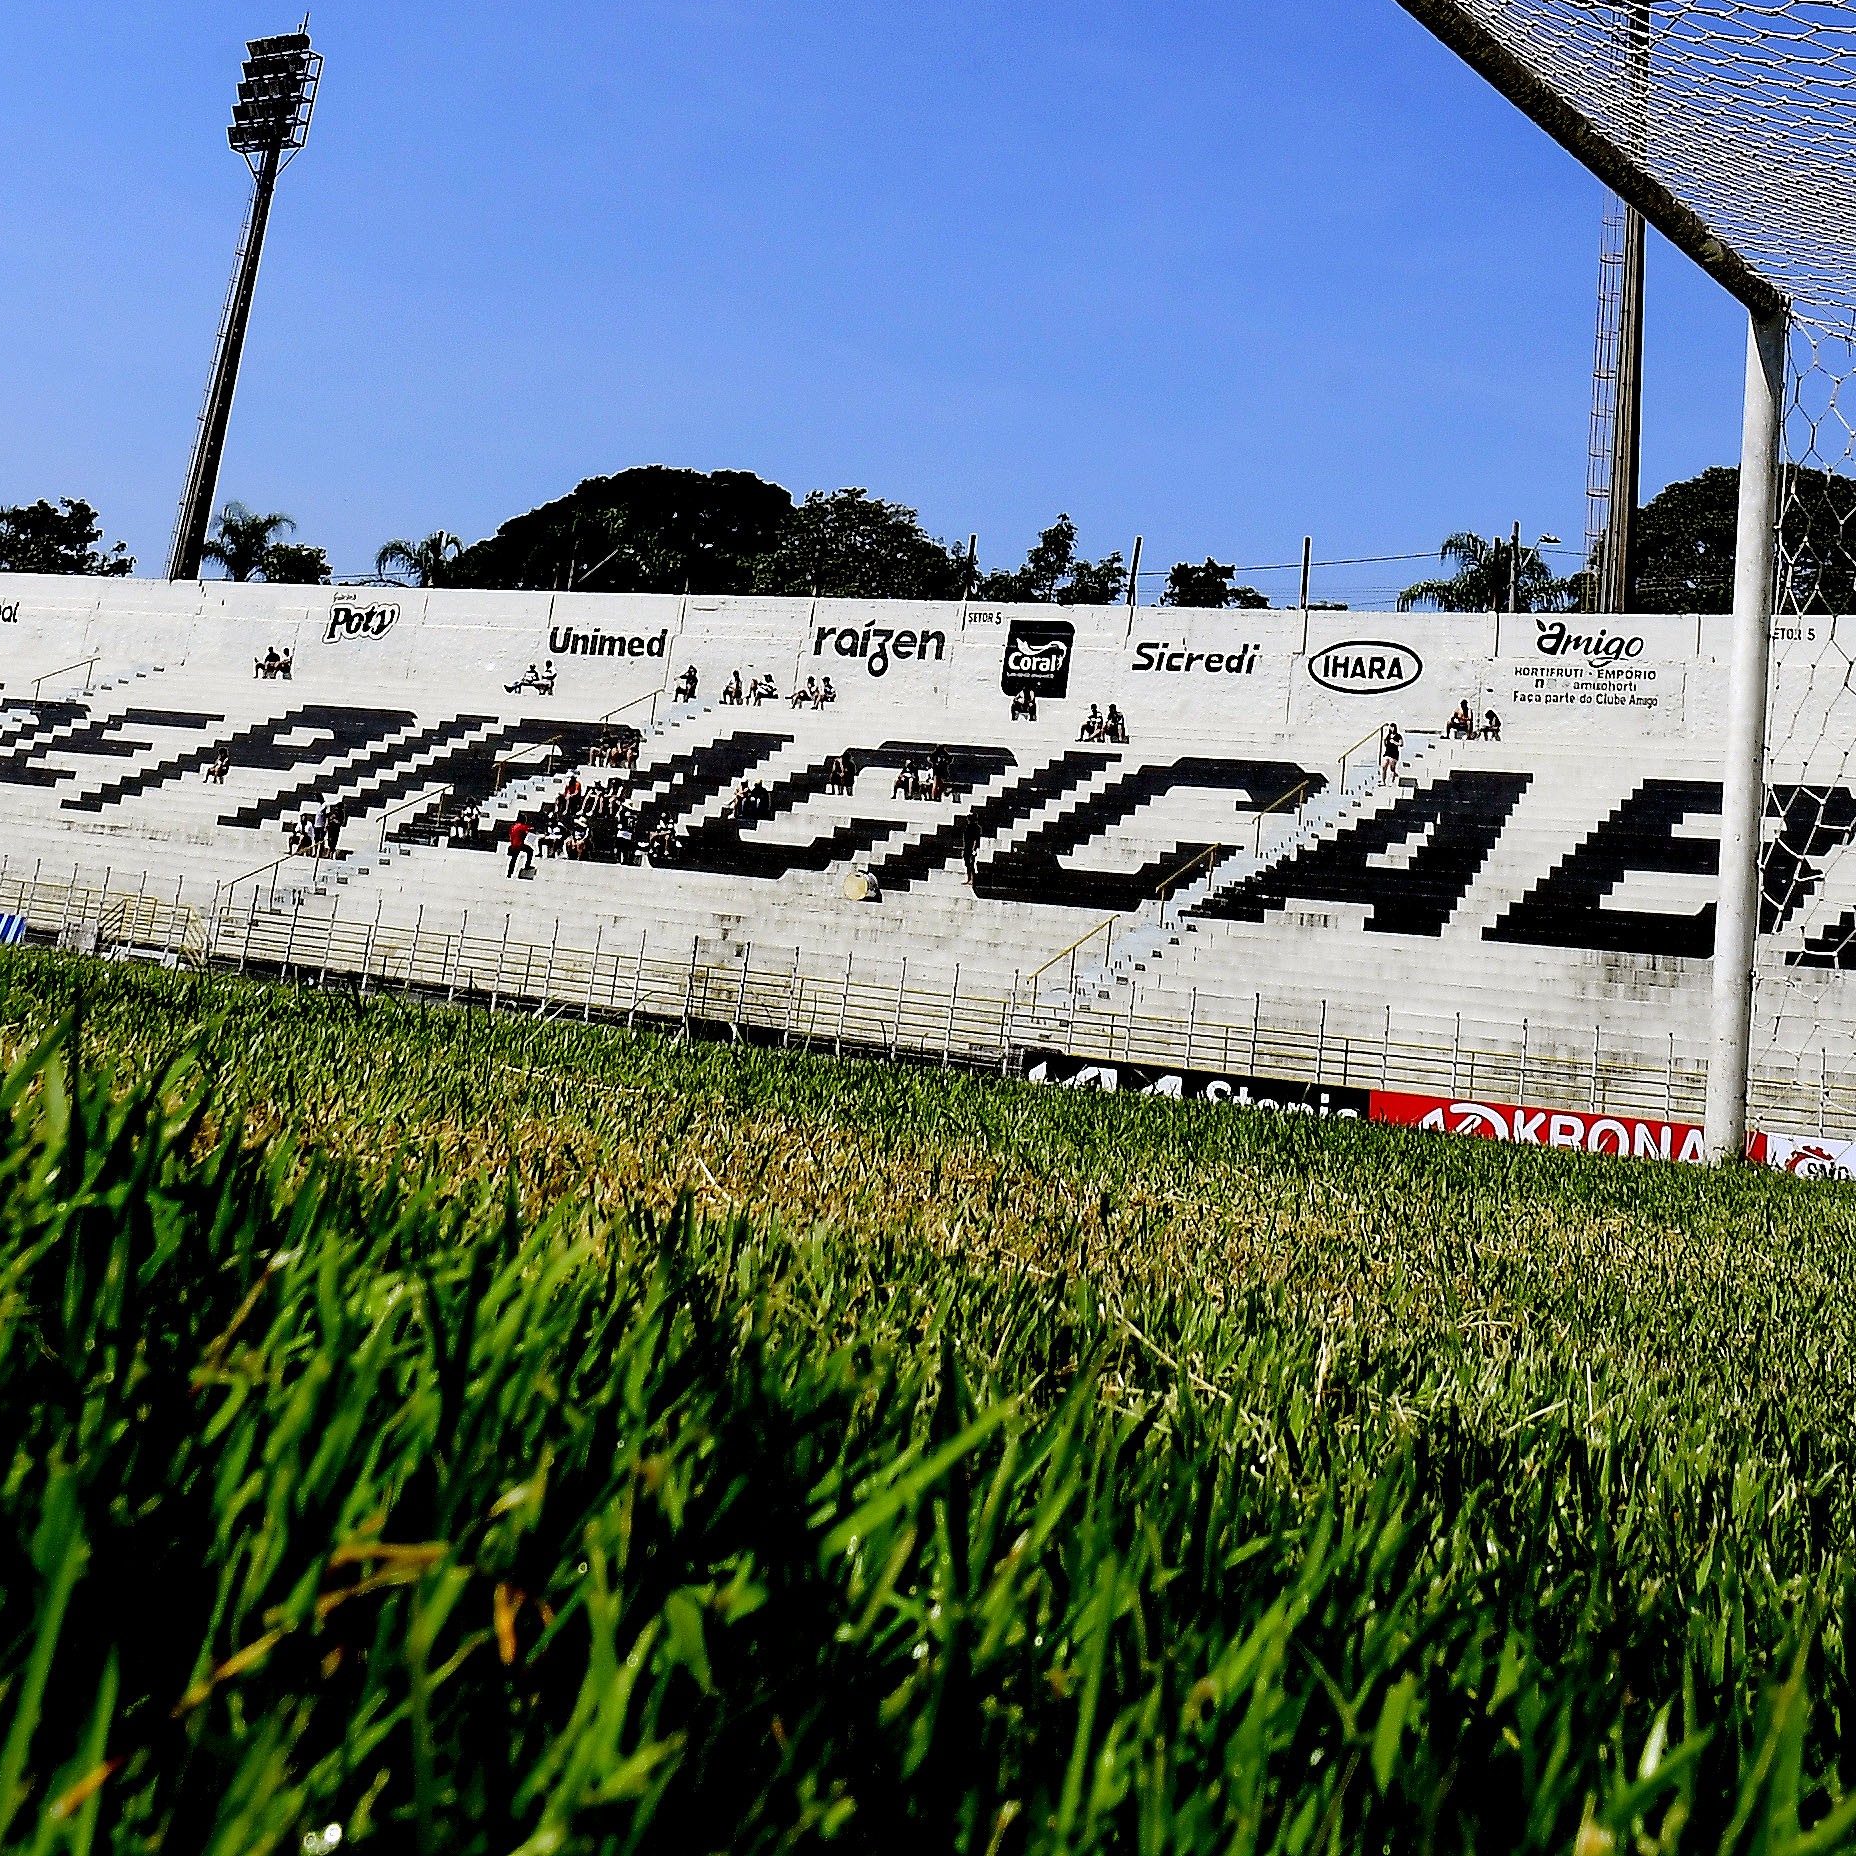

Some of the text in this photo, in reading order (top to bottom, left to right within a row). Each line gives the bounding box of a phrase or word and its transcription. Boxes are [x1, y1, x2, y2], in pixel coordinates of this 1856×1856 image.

[327, 605, 396, 637] Poty
[968, 612, 993, 623] SETOR
[549, 626, 668, 658] Unimed
[1772, 627, 1802, 641] ETOR
[813, 619, 946, 677] raízen
[1131, 641, 1261, 675] Sicredi
[1008, 651, 1057, 672] Coral
[1322, 655, 1404, 681] IHARA
[1514, 666, 1584, 679] HORTIFRUTI
[1513, 690, 1542, 704] Faça
[1544, 692, 1576, 704] parte
[1595, 693, 1627, 705] Clube
